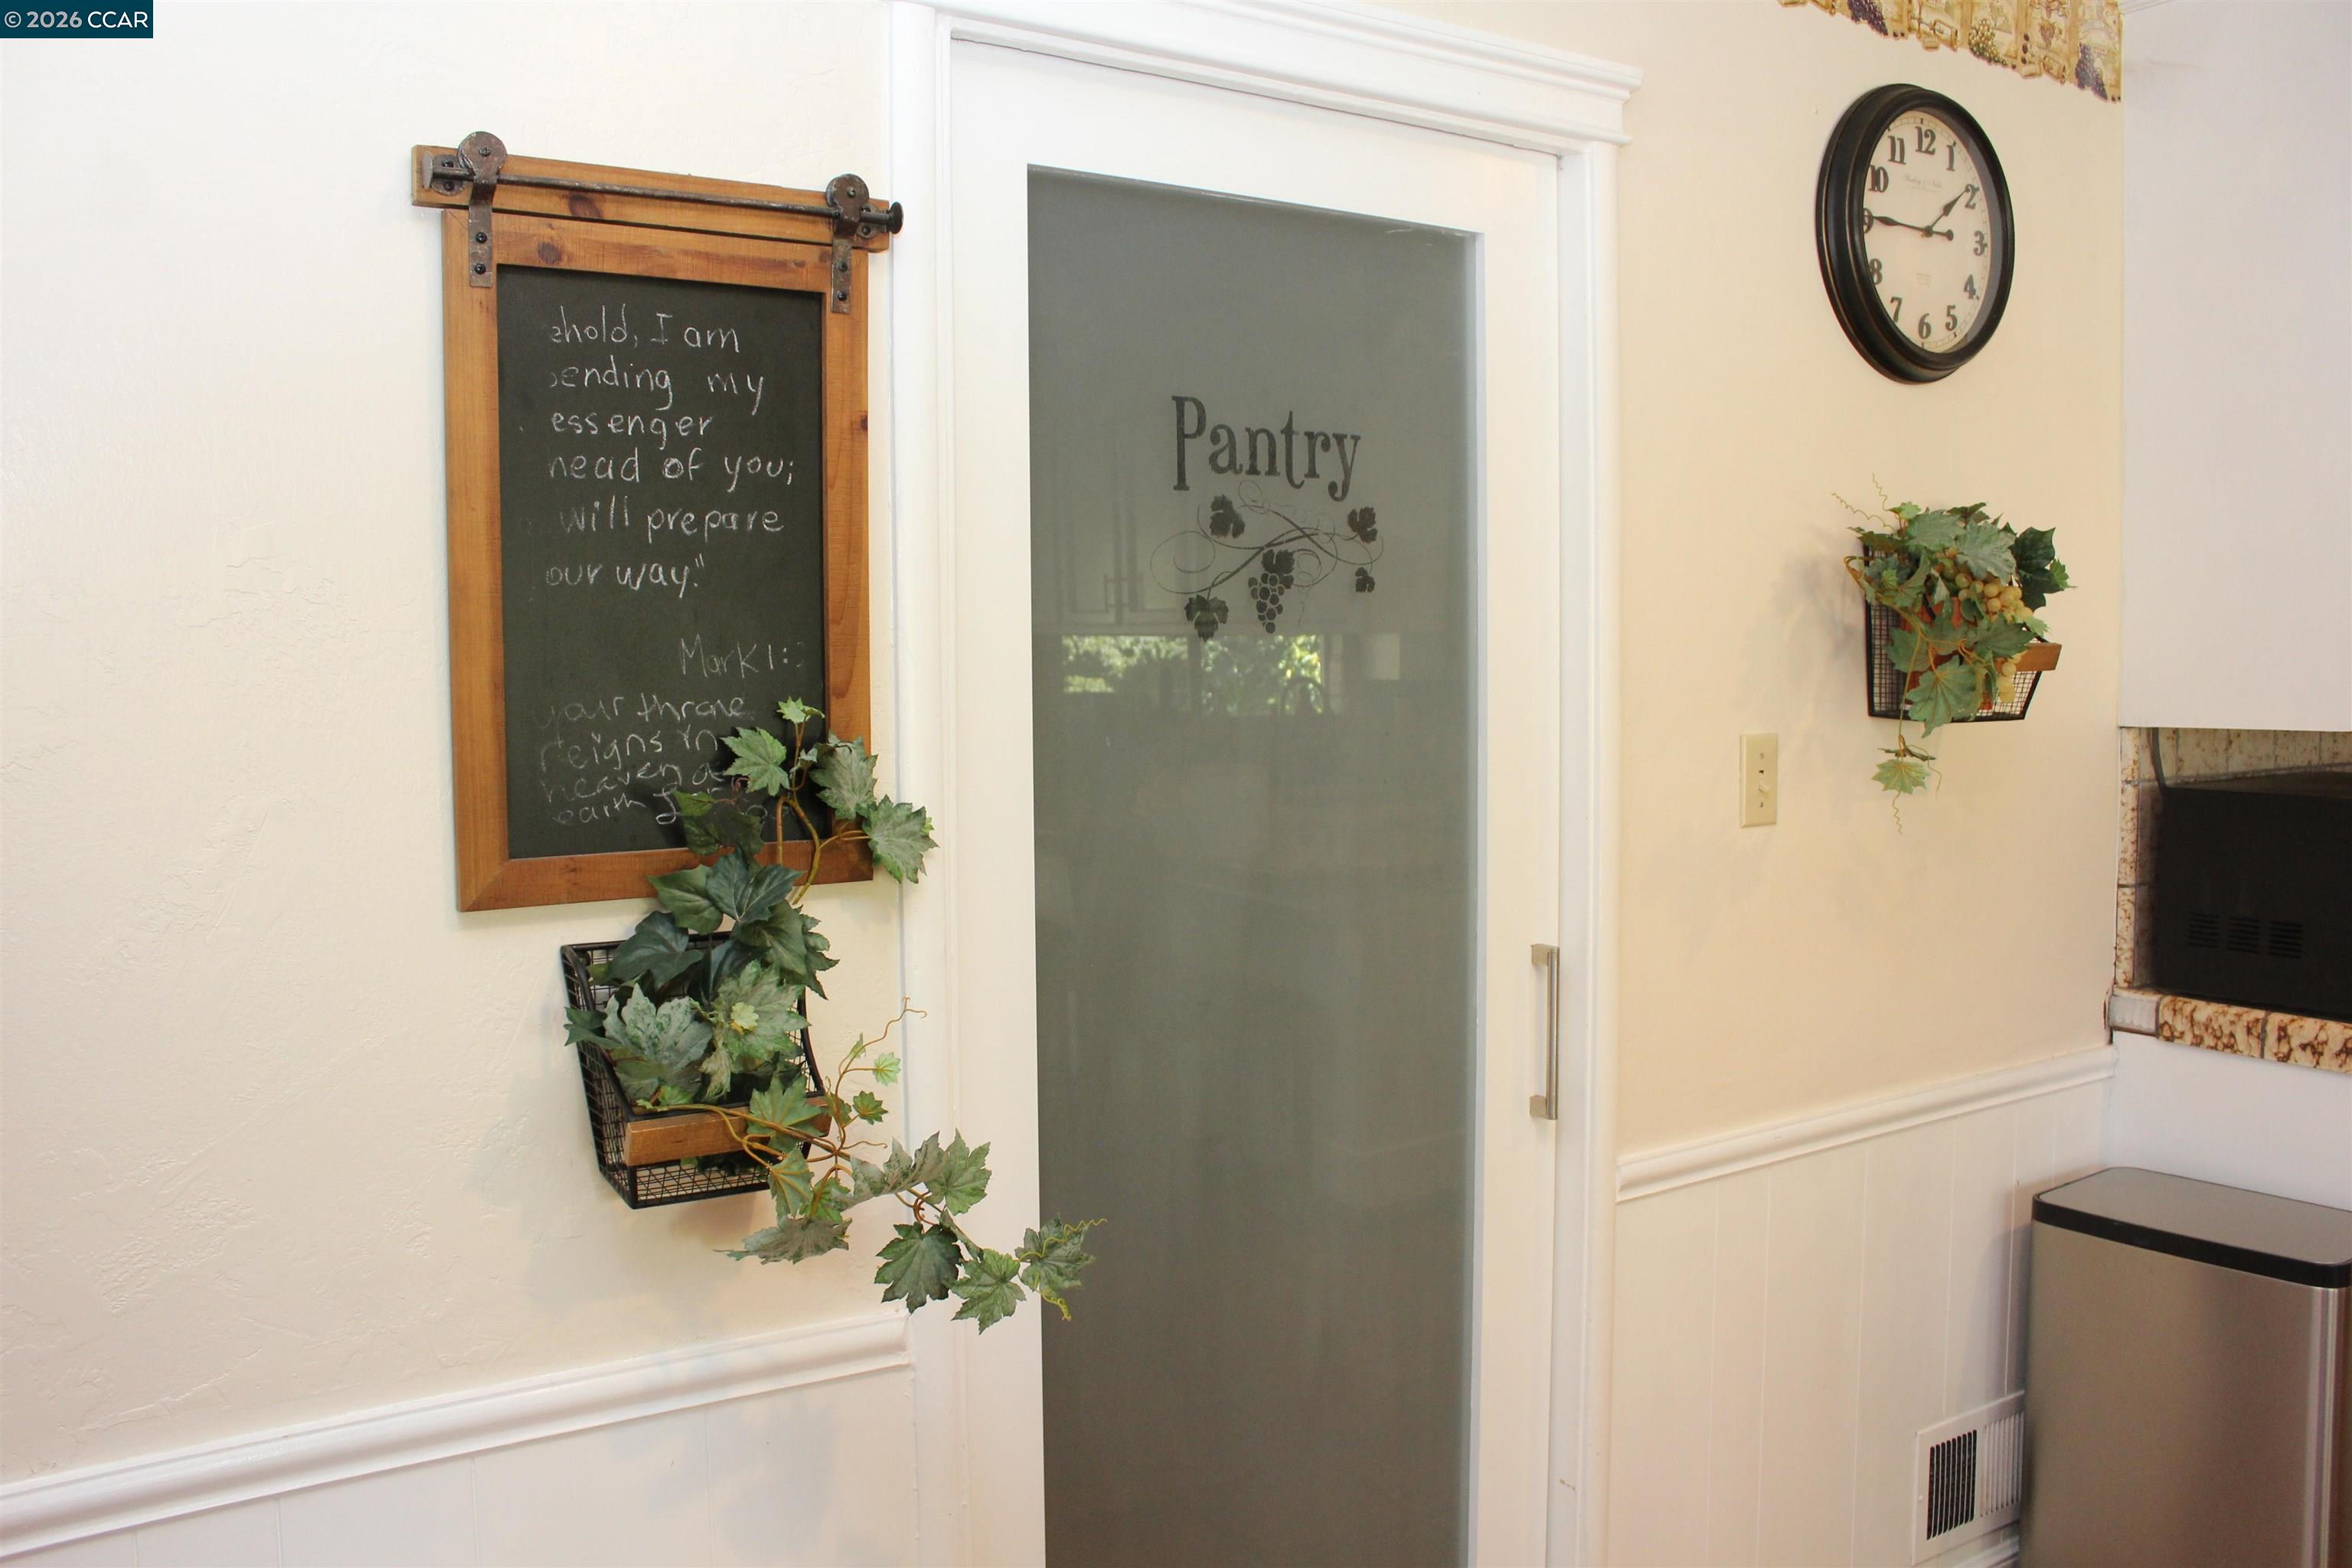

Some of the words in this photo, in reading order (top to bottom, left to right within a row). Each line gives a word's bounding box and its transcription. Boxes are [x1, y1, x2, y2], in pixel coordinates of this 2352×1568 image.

[1888, 136, 1906, 165] 11
[1915, 126, 1936, 155] 12
[1945, 144, 1955, 172] 1
[1868, 165, 1890, 193] 10
[1965, 184, 1979, 209] 2
[1863, 207, 1874, 234] 9
[1973, 230, 1988, 256] 3
[1869, 258, 1883, 285] 8
[1963, 274, 1977, 299] 4
[1890, 296, 1903, 322] 7
[1945, 305, 1958, 331] 5
[651, 312, 673, 345] I
[684, 325, 740, 353] am
[1918, 313, 1932, 339] 6
[707, 372, 764, 416] my
[1171, 395, 1361, 502] Pantry
[662, 447, 703, 480] of
[724, 456, 793, 492] you;
[560, 495, 629, 534] will
[647, 508, 784, 544] prepare
[681, 633, 759, 679] Mark
[541, 730, 662, 772] reigns
[677, 724, 718, 750] in
[540, 762, 681, 802] heaven
[552, 792, 647, 825] earth
